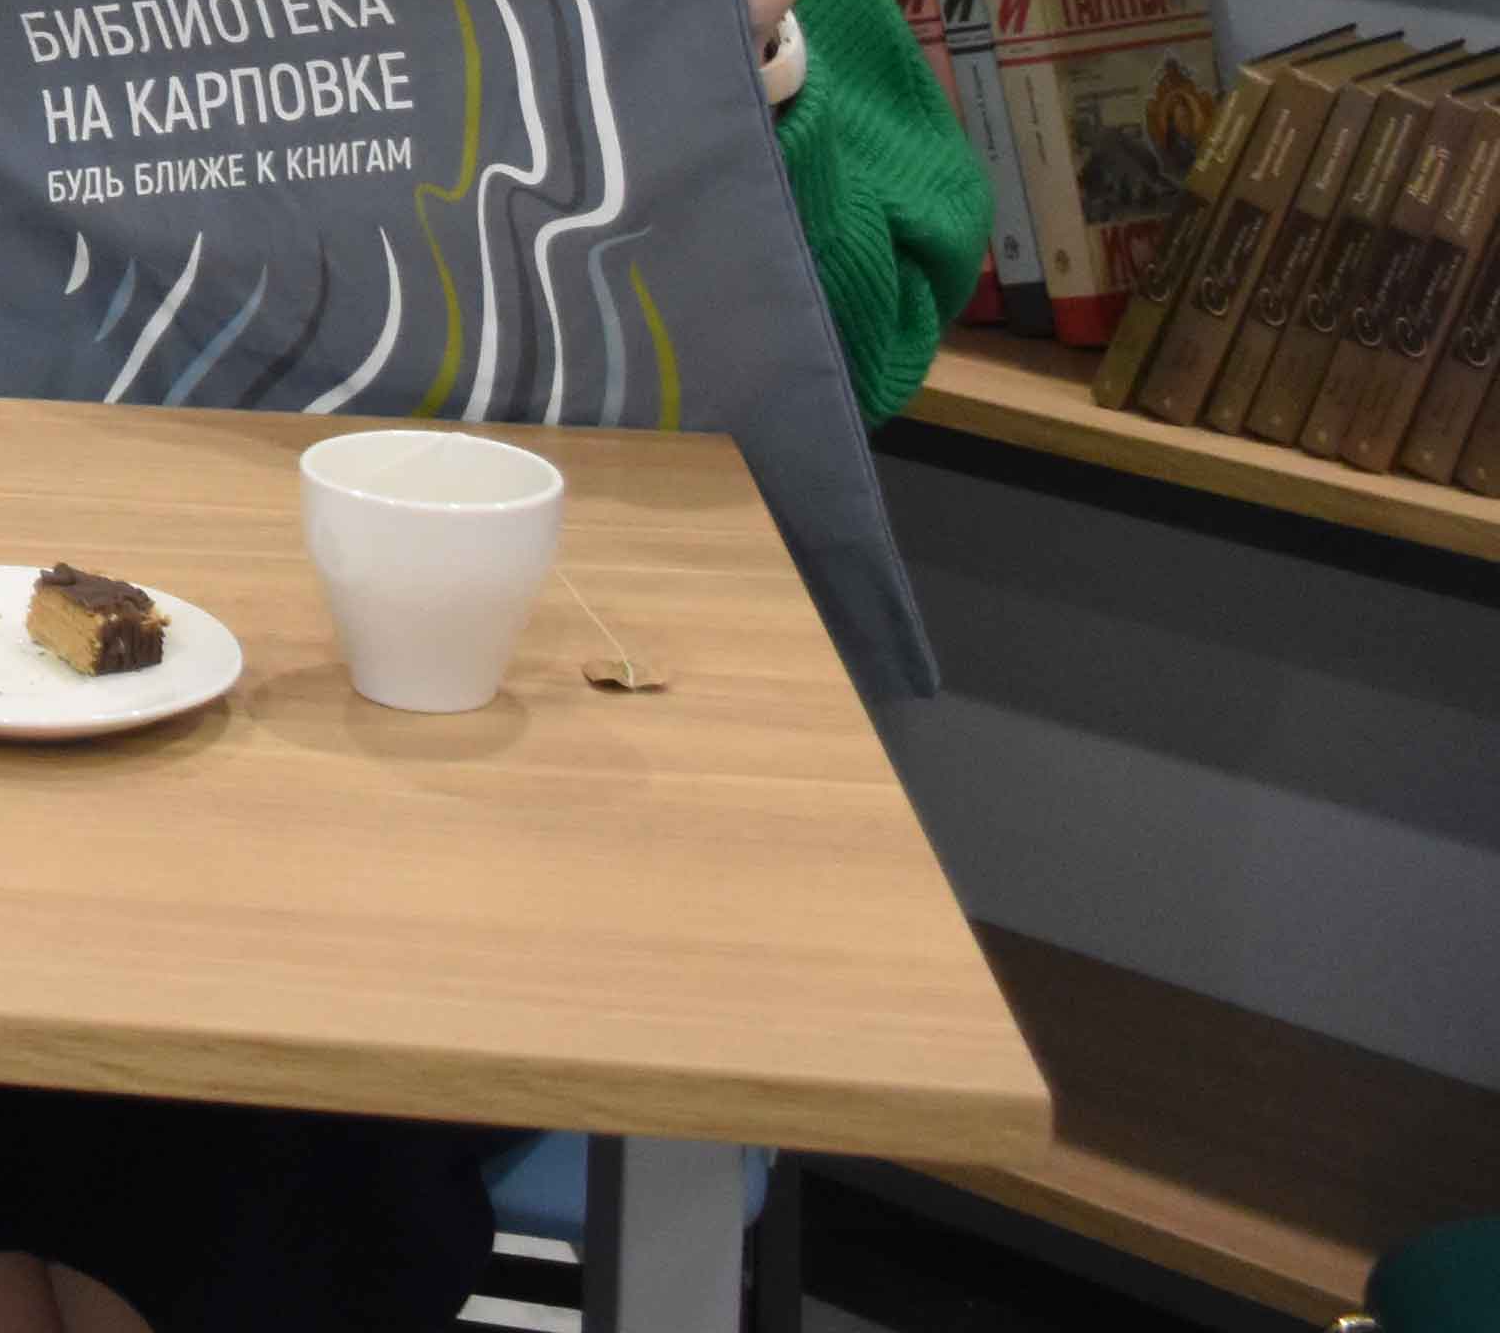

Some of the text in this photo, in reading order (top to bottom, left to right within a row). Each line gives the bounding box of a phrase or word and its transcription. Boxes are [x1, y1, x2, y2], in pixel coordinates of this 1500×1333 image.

[42, 51, 413, 143] НА КАРПОВКЕ
[47, 137, 411, 204] БУДЬ БЛИЖЕ К КНИГАМ
